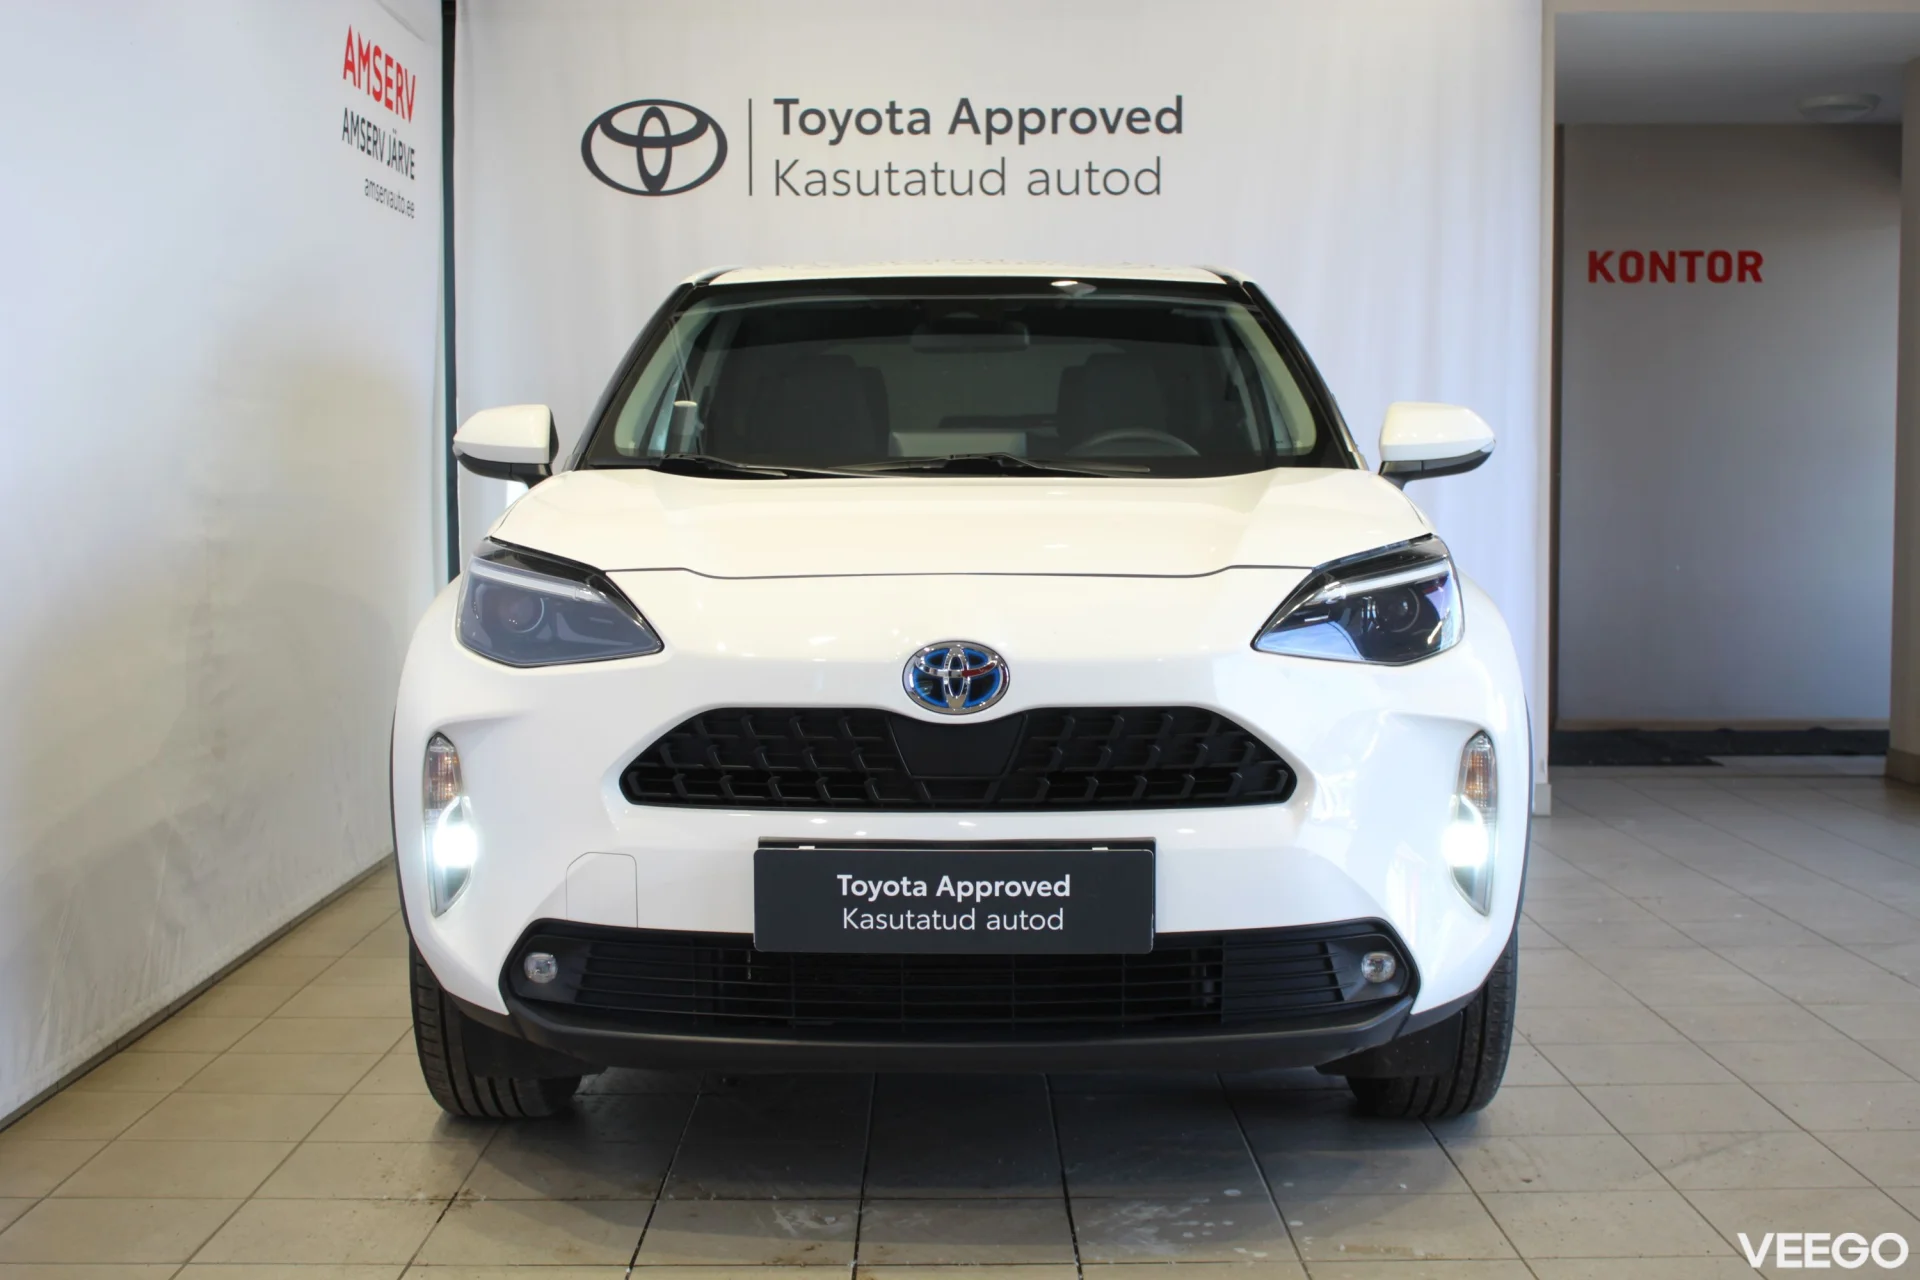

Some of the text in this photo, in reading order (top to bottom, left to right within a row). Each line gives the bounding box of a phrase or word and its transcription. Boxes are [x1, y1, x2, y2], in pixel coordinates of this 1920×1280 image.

[343, 24, 416, 124] AMSERV
[774, 95, 1184, 146] Toyota Approved
[342, 107, 415, 181] AMSERV JÄRVE
[774, 156, 1162, 197] Kasutatud autod
[364, 178, 415, 220] amservauto.ee
[1588, 250, 1764, 284] KONTOR
[836, 874, 1072, 904] Toyota Approved
[842, 907, 1064, 931] Kasutatud autod
